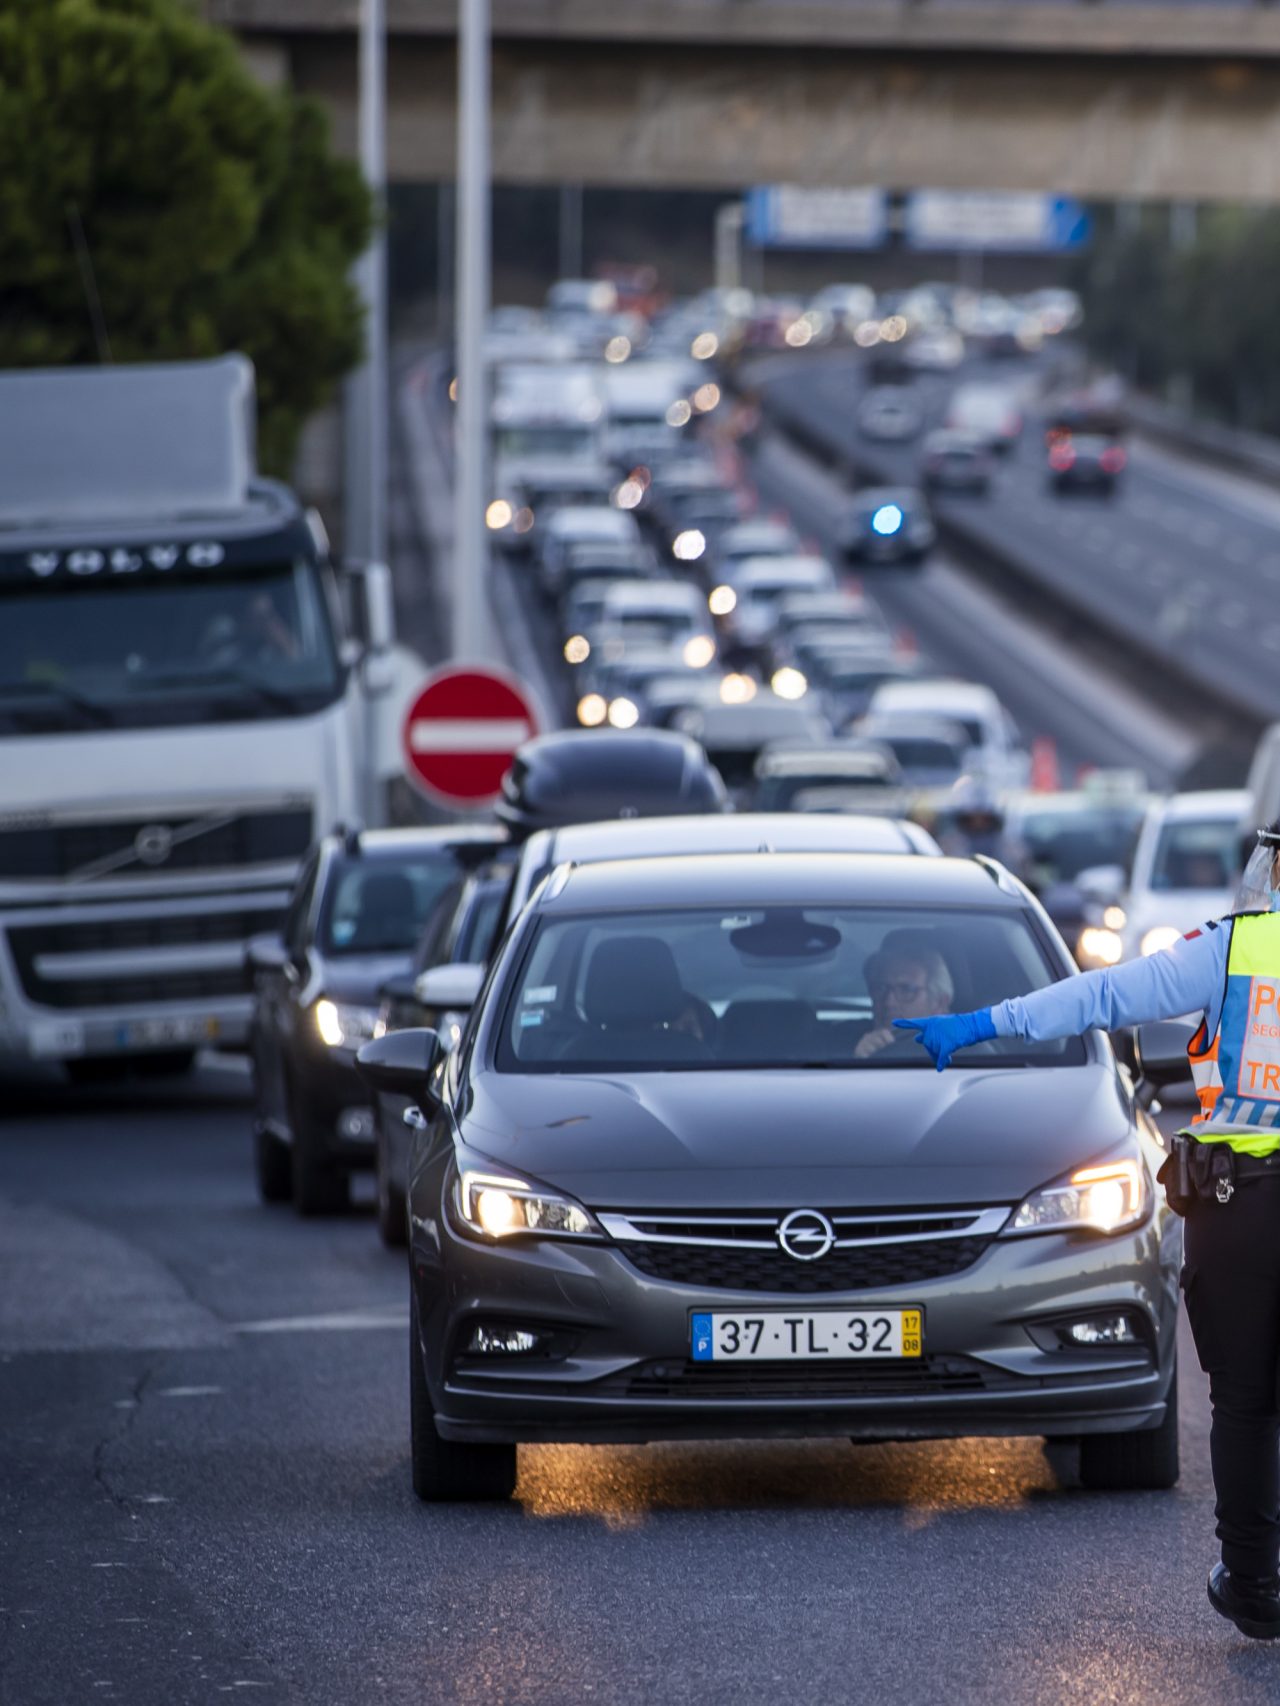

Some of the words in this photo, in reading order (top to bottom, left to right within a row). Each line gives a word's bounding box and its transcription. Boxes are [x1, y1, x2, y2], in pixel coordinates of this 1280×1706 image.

[28, 542, 225, 577] VOLVO
[903, 1316, 918, 1329] 17
[903, 1339, 919, 1352] 08
